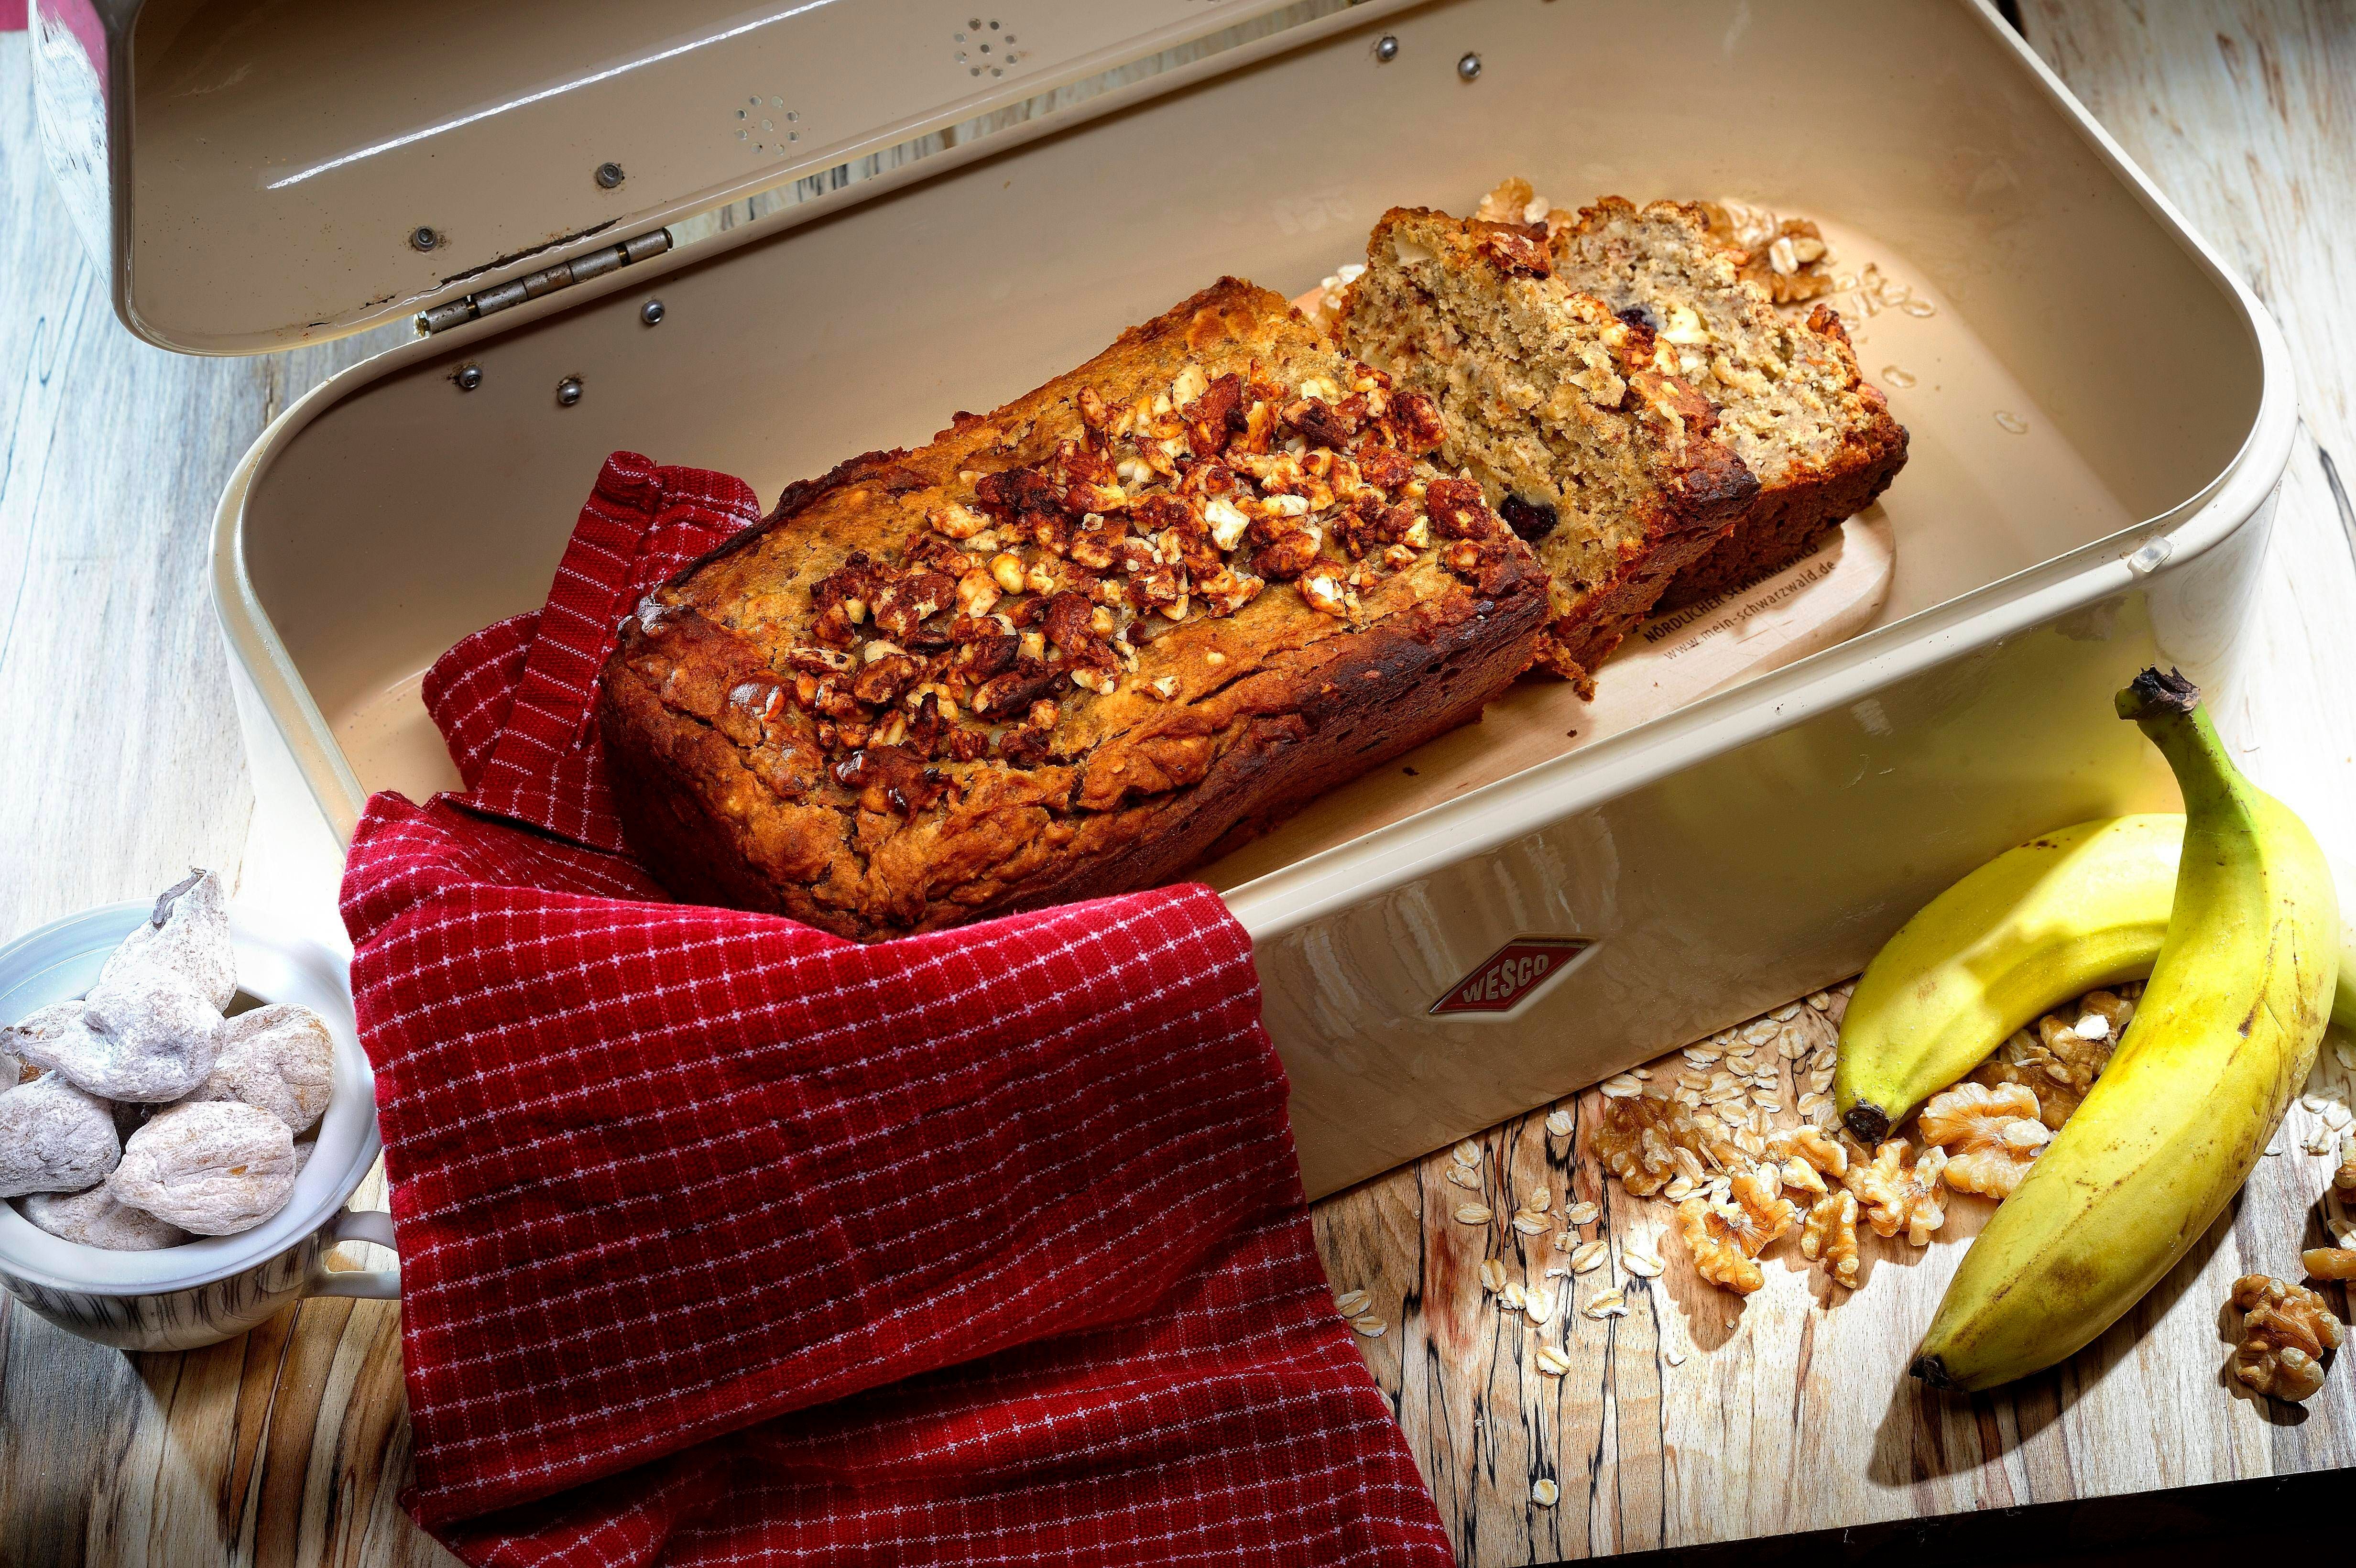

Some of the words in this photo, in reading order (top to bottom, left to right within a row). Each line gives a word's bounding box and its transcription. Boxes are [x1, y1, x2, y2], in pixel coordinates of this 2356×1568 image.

[1643, 594, 1726, 643] NÖRDLICHER
[1663, 561, 1836, 660] www.mein-schwarzwald.de
[1462, 954, 1549, 1003] WESCO
